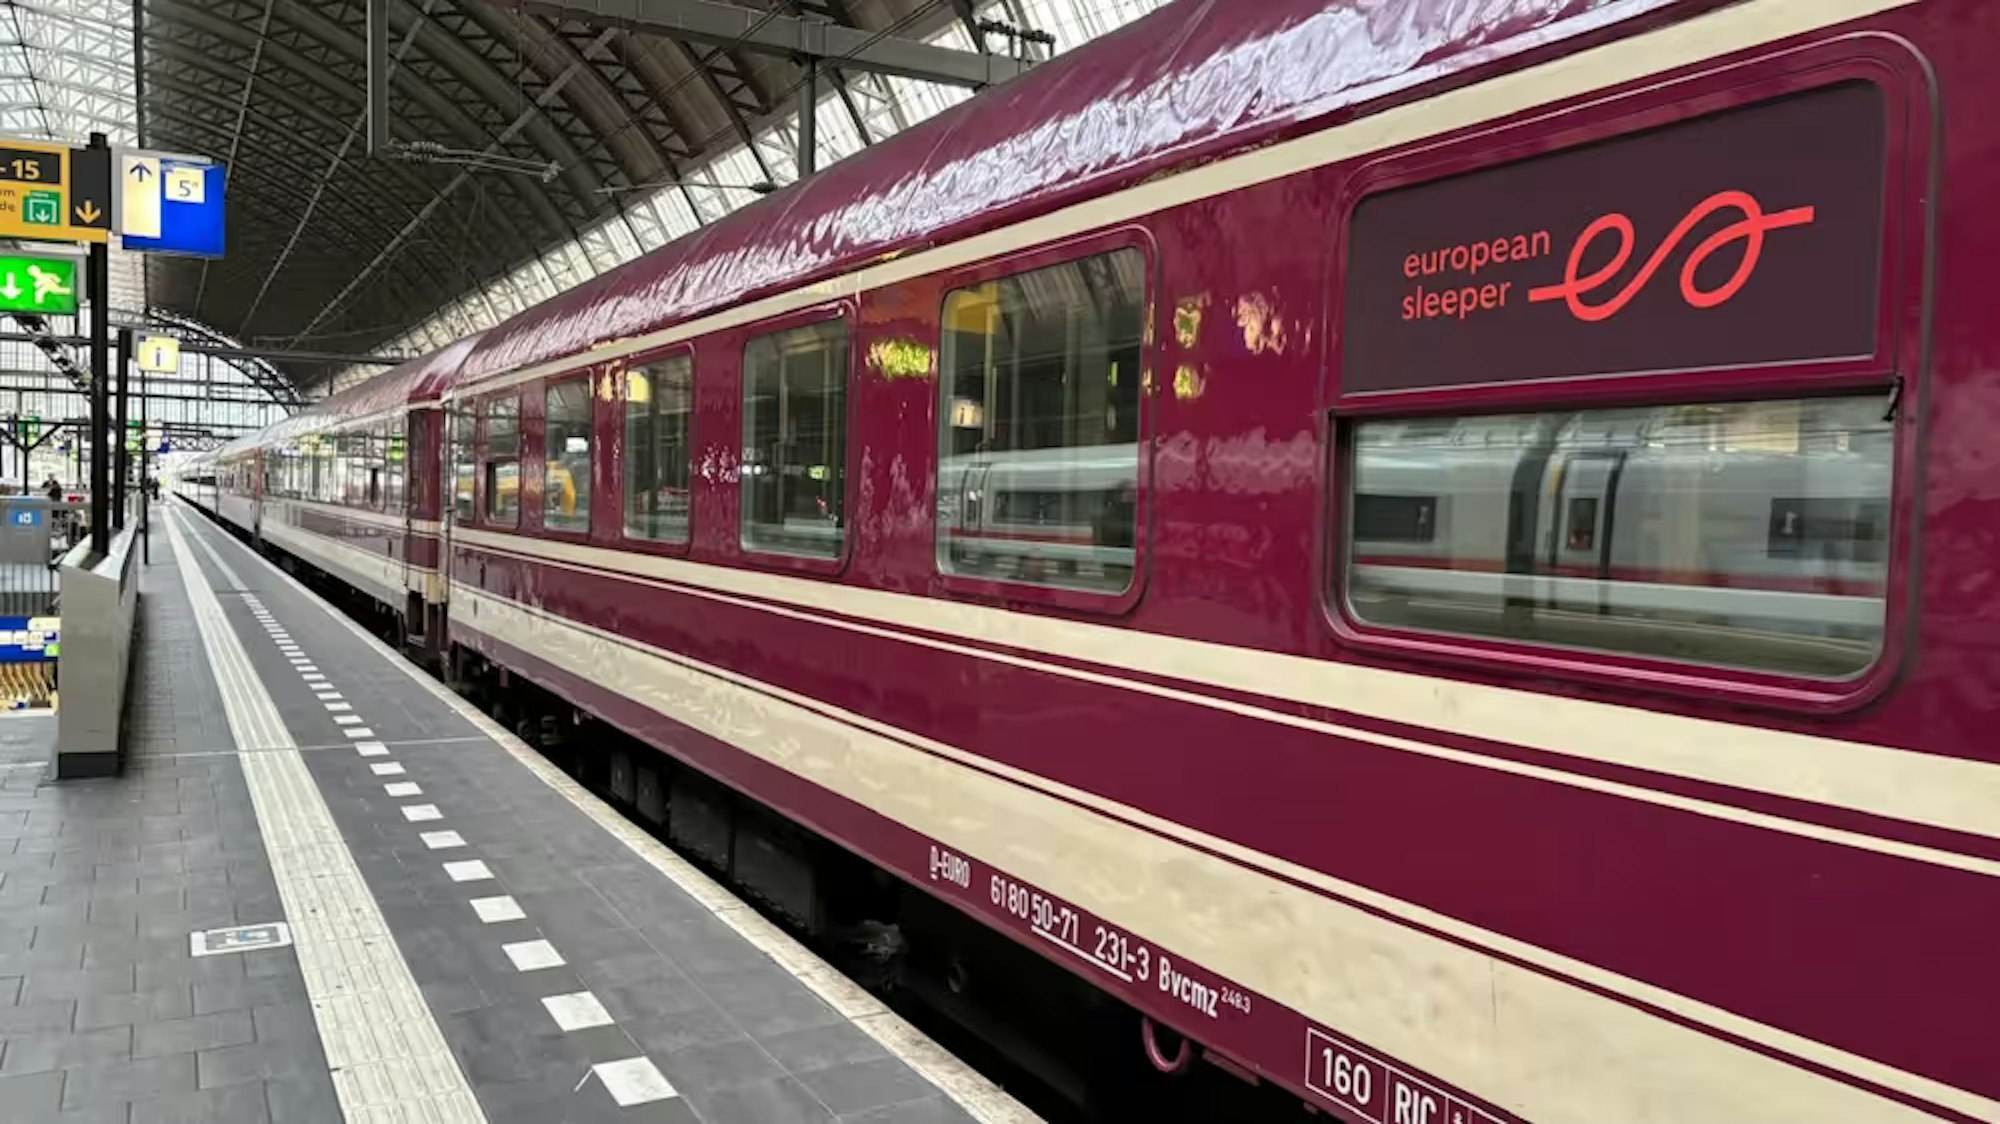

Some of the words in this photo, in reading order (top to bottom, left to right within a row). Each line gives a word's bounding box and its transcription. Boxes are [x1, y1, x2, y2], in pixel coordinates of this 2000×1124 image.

[11, 159, 40, 180] 15
[1403, 230, 1551, 277] european
[1402, 281, 1512, 320] sleeper
[930, 845, 970, 888] D-EURO
[991, 875, 1029, 919] 6180
[1031, 893, 1081, 945] 50-71
[1095, 927, 1150, 981] 231-3
[1159, 955, 1218, 1018] Bvcmz
[1322, 1048, 1372, 1105] 160
[1395, 1081, 1437, 1124] RIC
